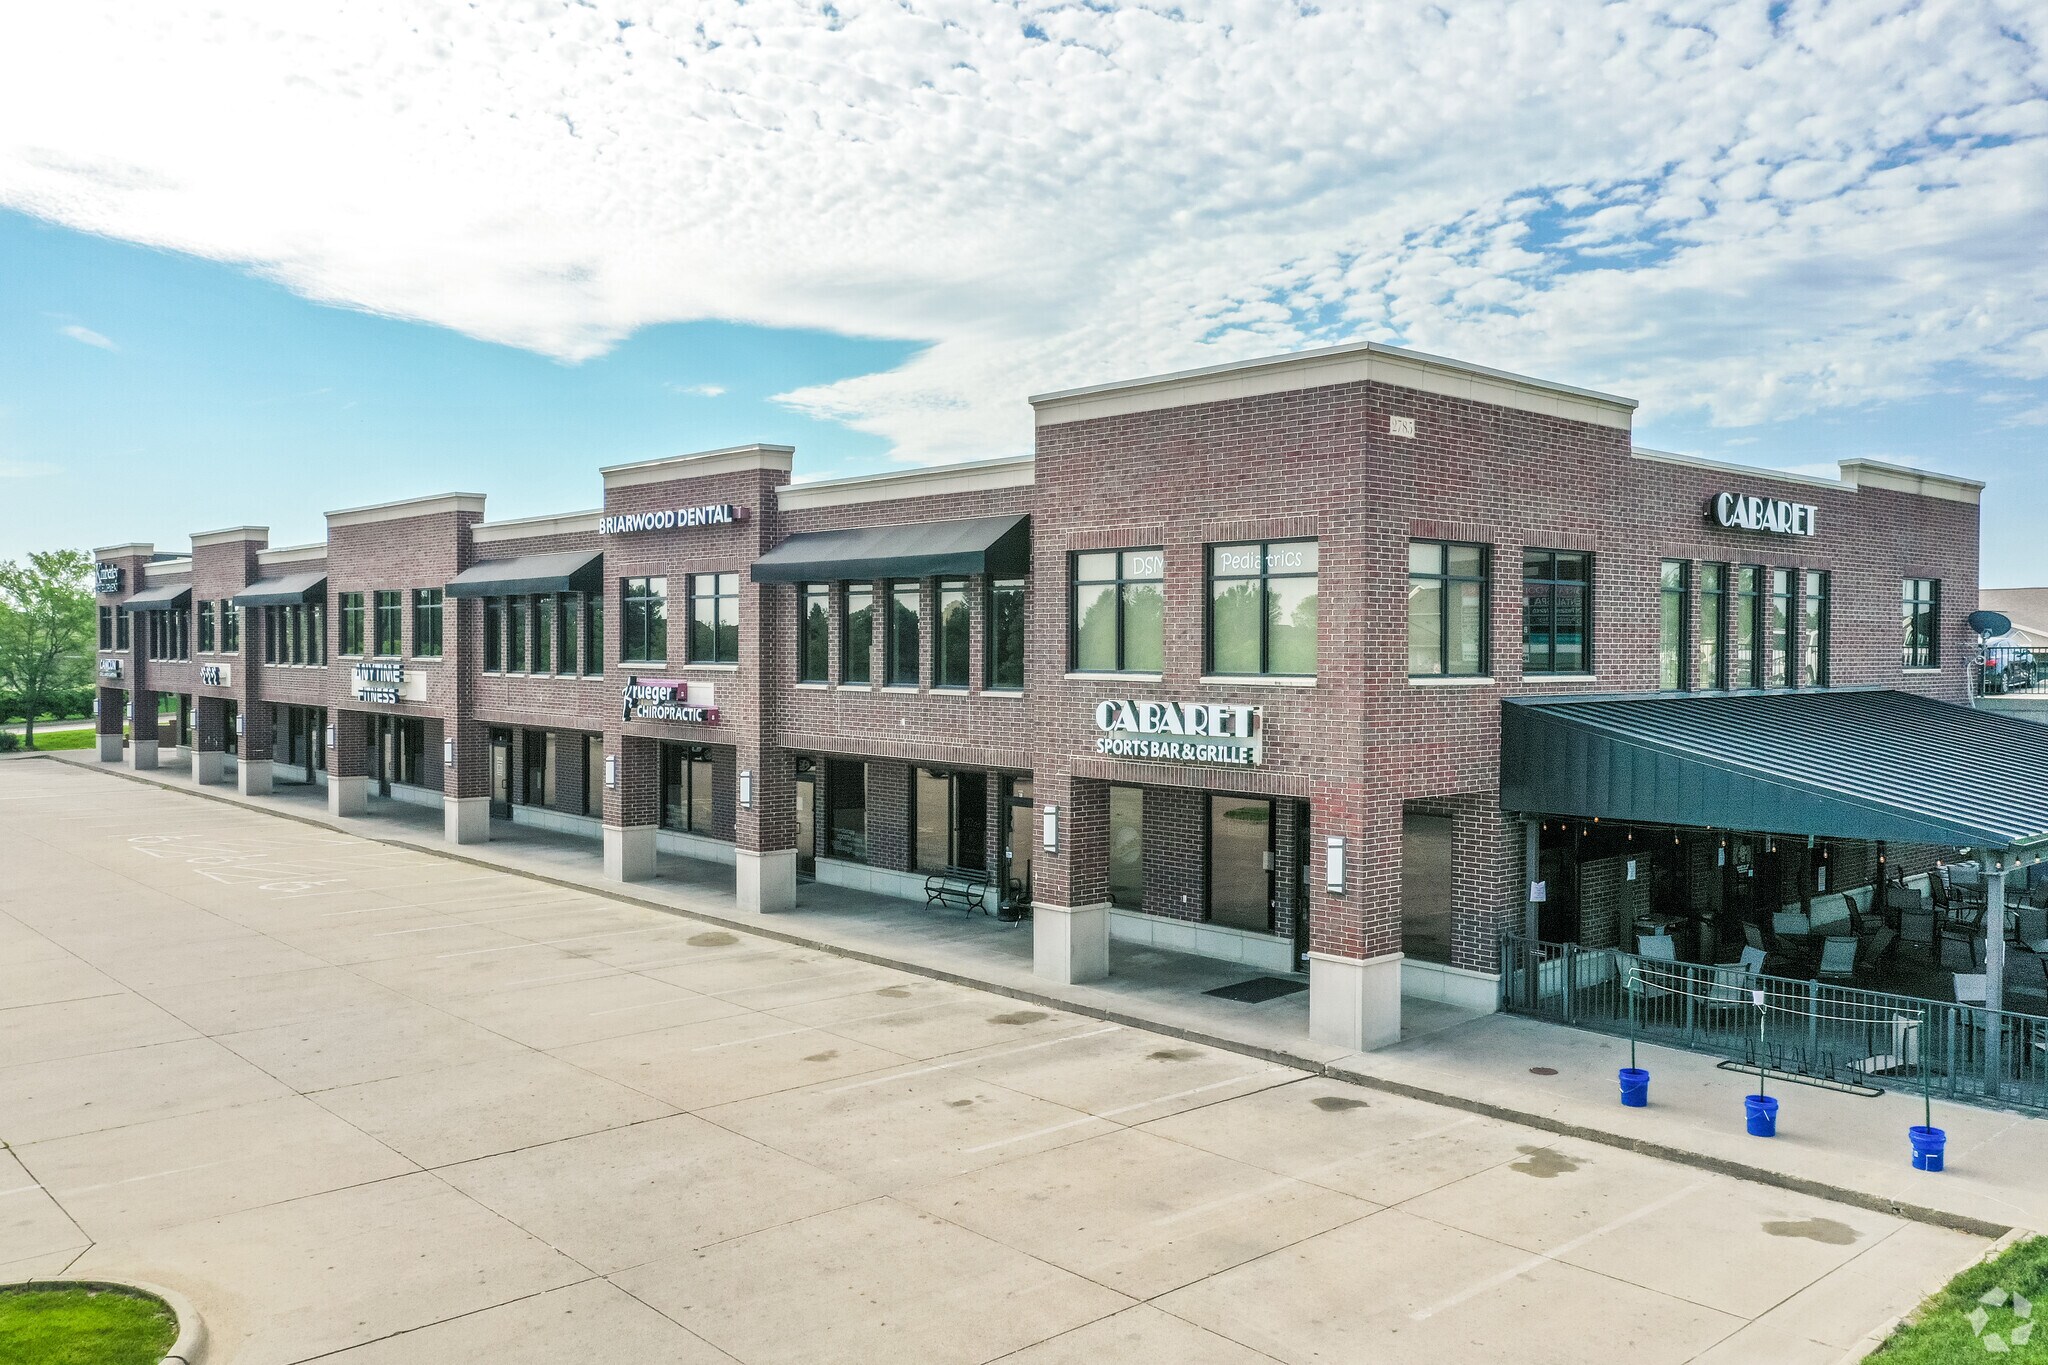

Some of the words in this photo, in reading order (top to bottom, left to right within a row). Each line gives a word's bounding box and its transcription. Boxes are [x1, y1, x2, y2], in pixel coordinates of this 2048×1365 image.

[599, 510, 675, 534] BRIARWOOD
[677, 504, 733, 527] DENTAL
[1717, 492, 1819, 536] CABARET
[1220, 549, 1303, 572] Pediatrics
[355, 663, 400, 683] ANYTIME
[357, 687, 396, 704] FITNESS
[637, 704, 702, 722] CHIROPRACTIC
[1095, 700, 1255, 738] CABARET
[1096, 738, 1149, 756] SPORTS
[1150, 741, 1181, 760] BAR
[1196, 745, 1248, 763] GRILLE
